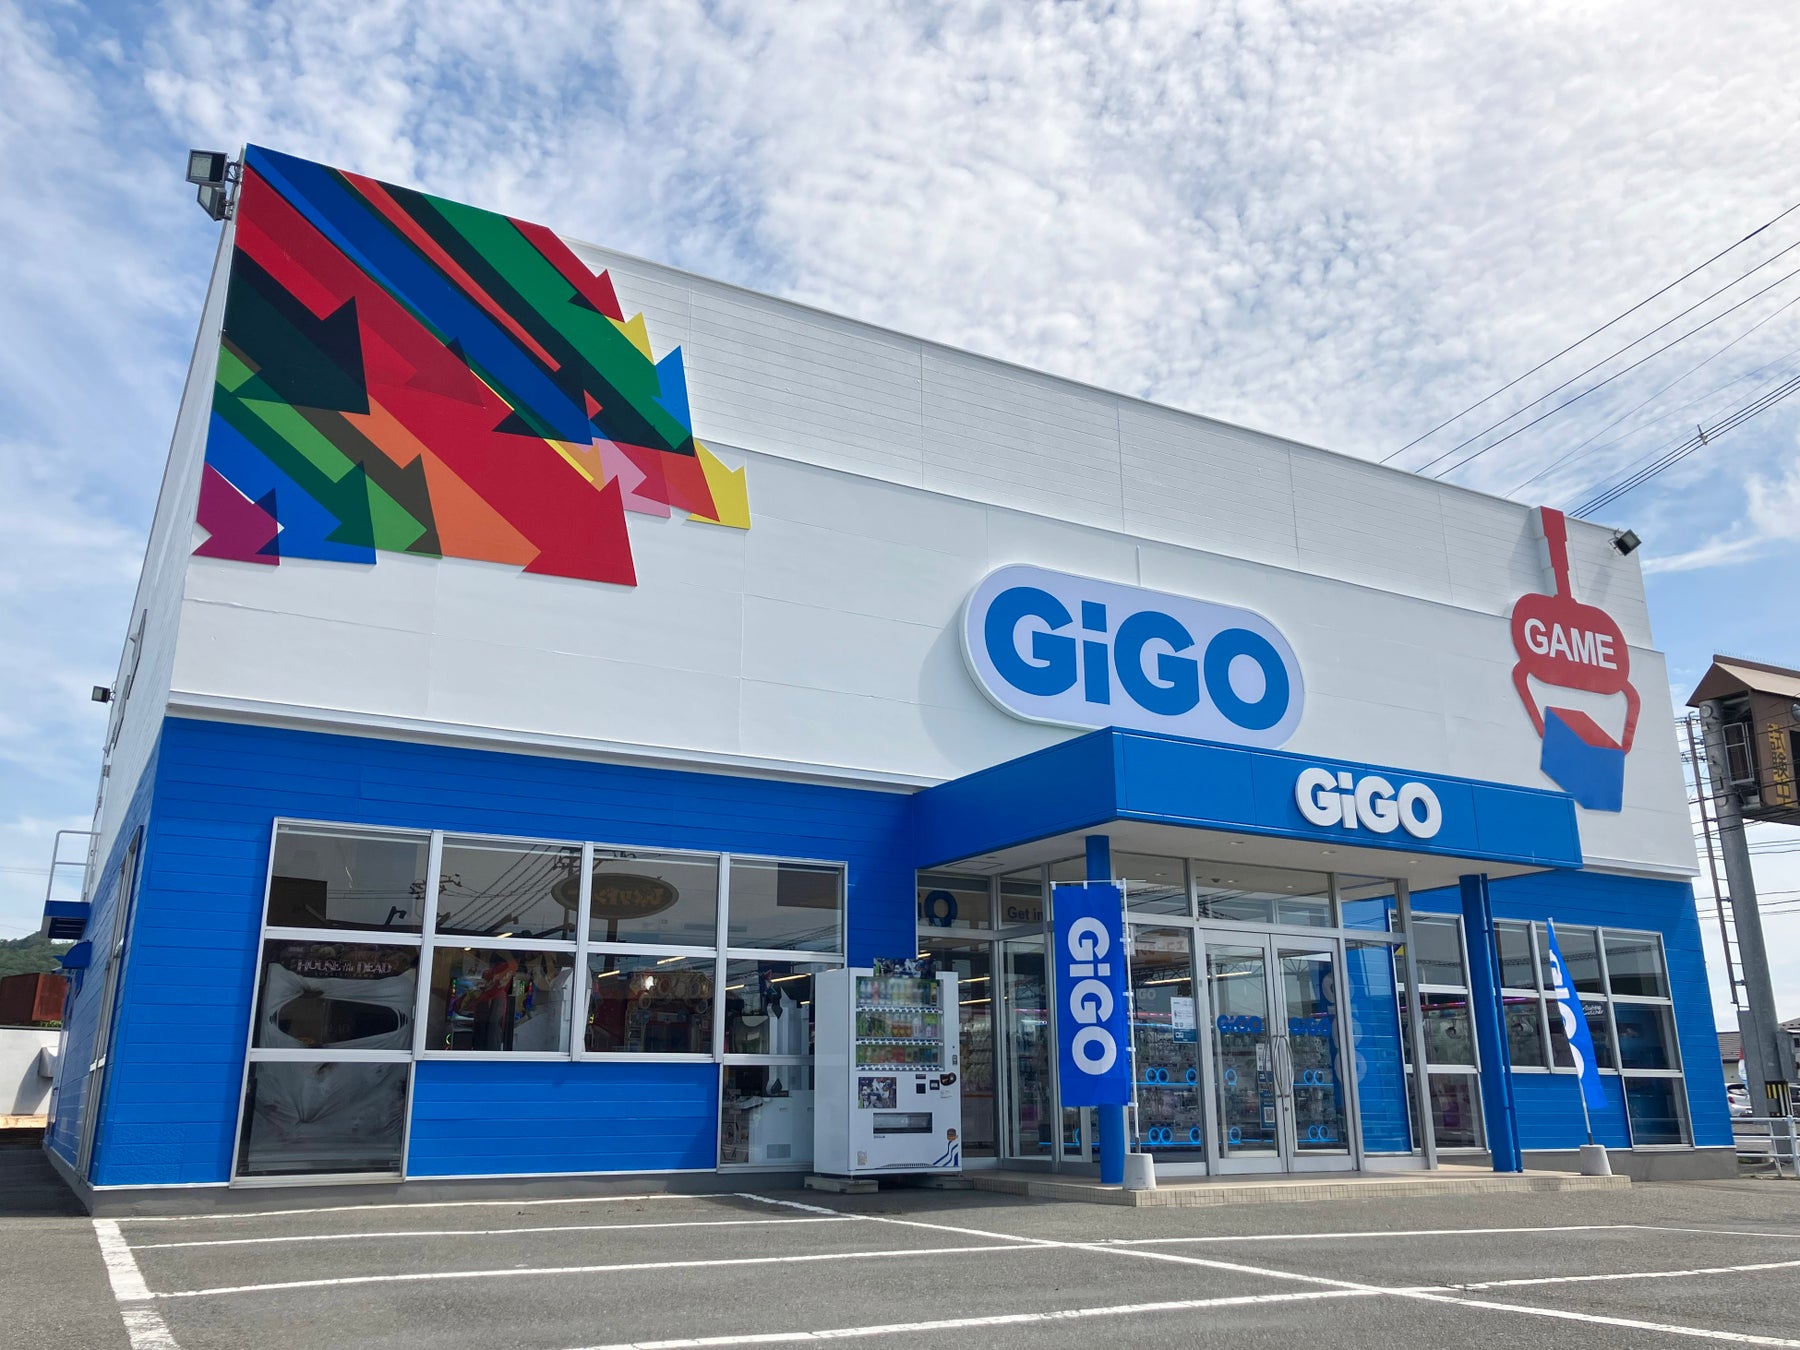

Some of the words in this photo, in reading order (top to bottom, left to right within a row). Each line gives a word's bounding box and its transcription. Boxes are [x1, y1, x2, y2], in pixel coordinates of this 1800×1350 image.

[984, 587, 1290, 731] GiGO
[1524, 617, 1618, 670] GAME
[1294, 767, 1442, 839] GiGO
[1007, 906, 1029, 920] Get
[1067, 916, 1117, 1076] GiGO
